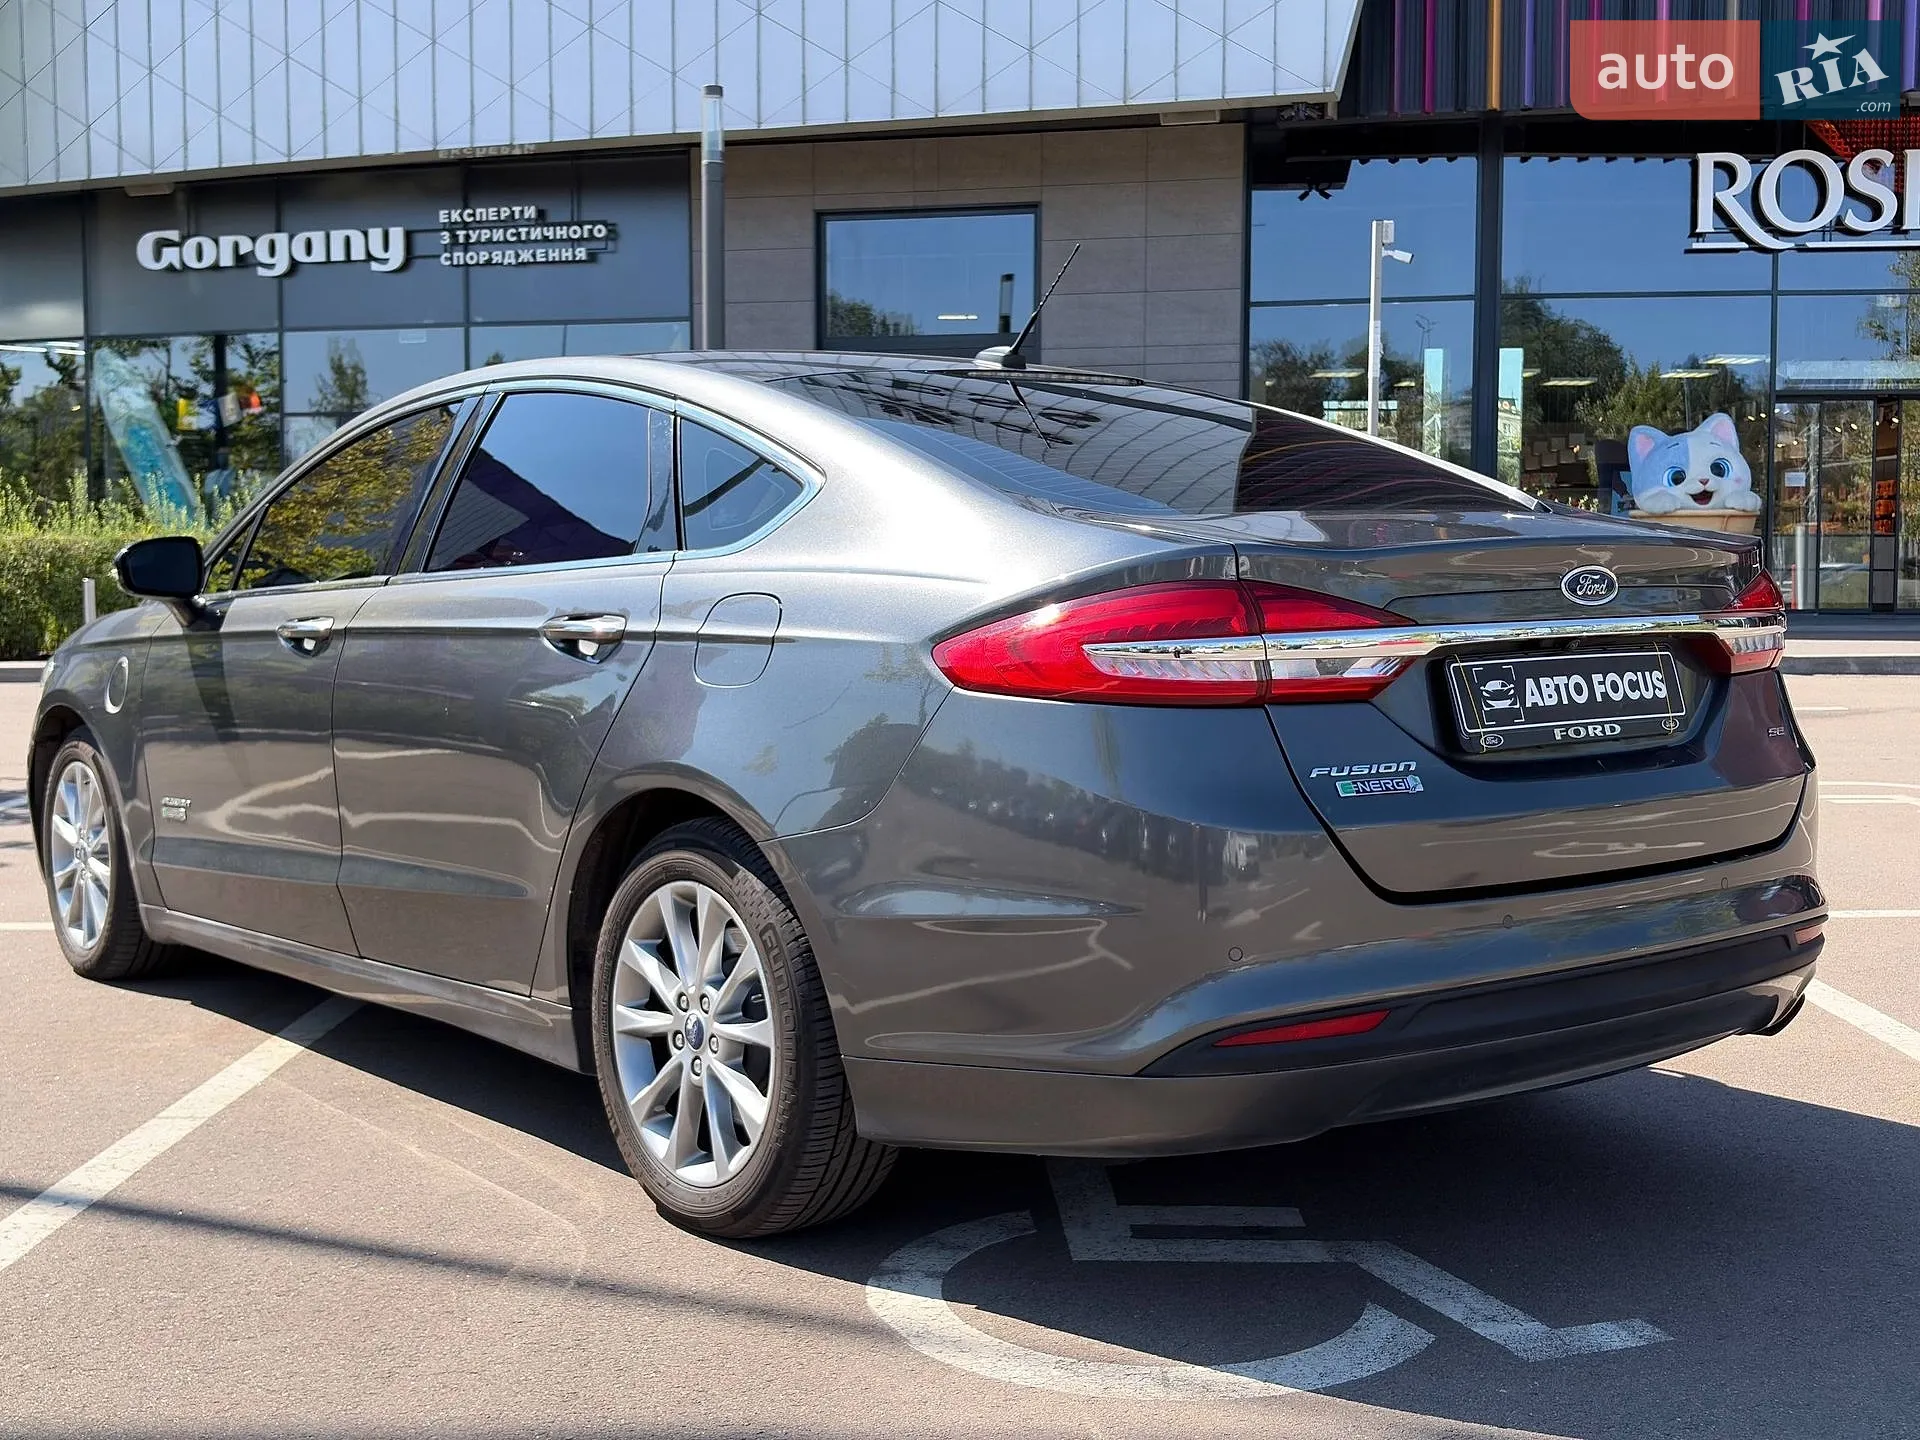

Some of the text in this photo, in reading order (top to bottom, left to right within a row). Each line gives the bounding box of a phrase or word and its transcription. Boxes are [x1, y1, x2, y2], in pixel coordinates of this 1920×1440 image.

[438, 205, 538, 224] ЕКСПЕРТИ
[456, 224, 608, 245] ТУРИСТИЧНОГО
[136, 226, 406, 277] Gorgany
[439, 247, 588, 267] СПОРЯДЖЕННЯ
[1576, 573, 1608, 596] Ford
[1592, 670, 1667, 702] FOCUS
[1553, 723, 1622, 741] FORD
[1308, 761, 1417, 778] FUSION
[1340, 778, 1411, 796] ENERGI
